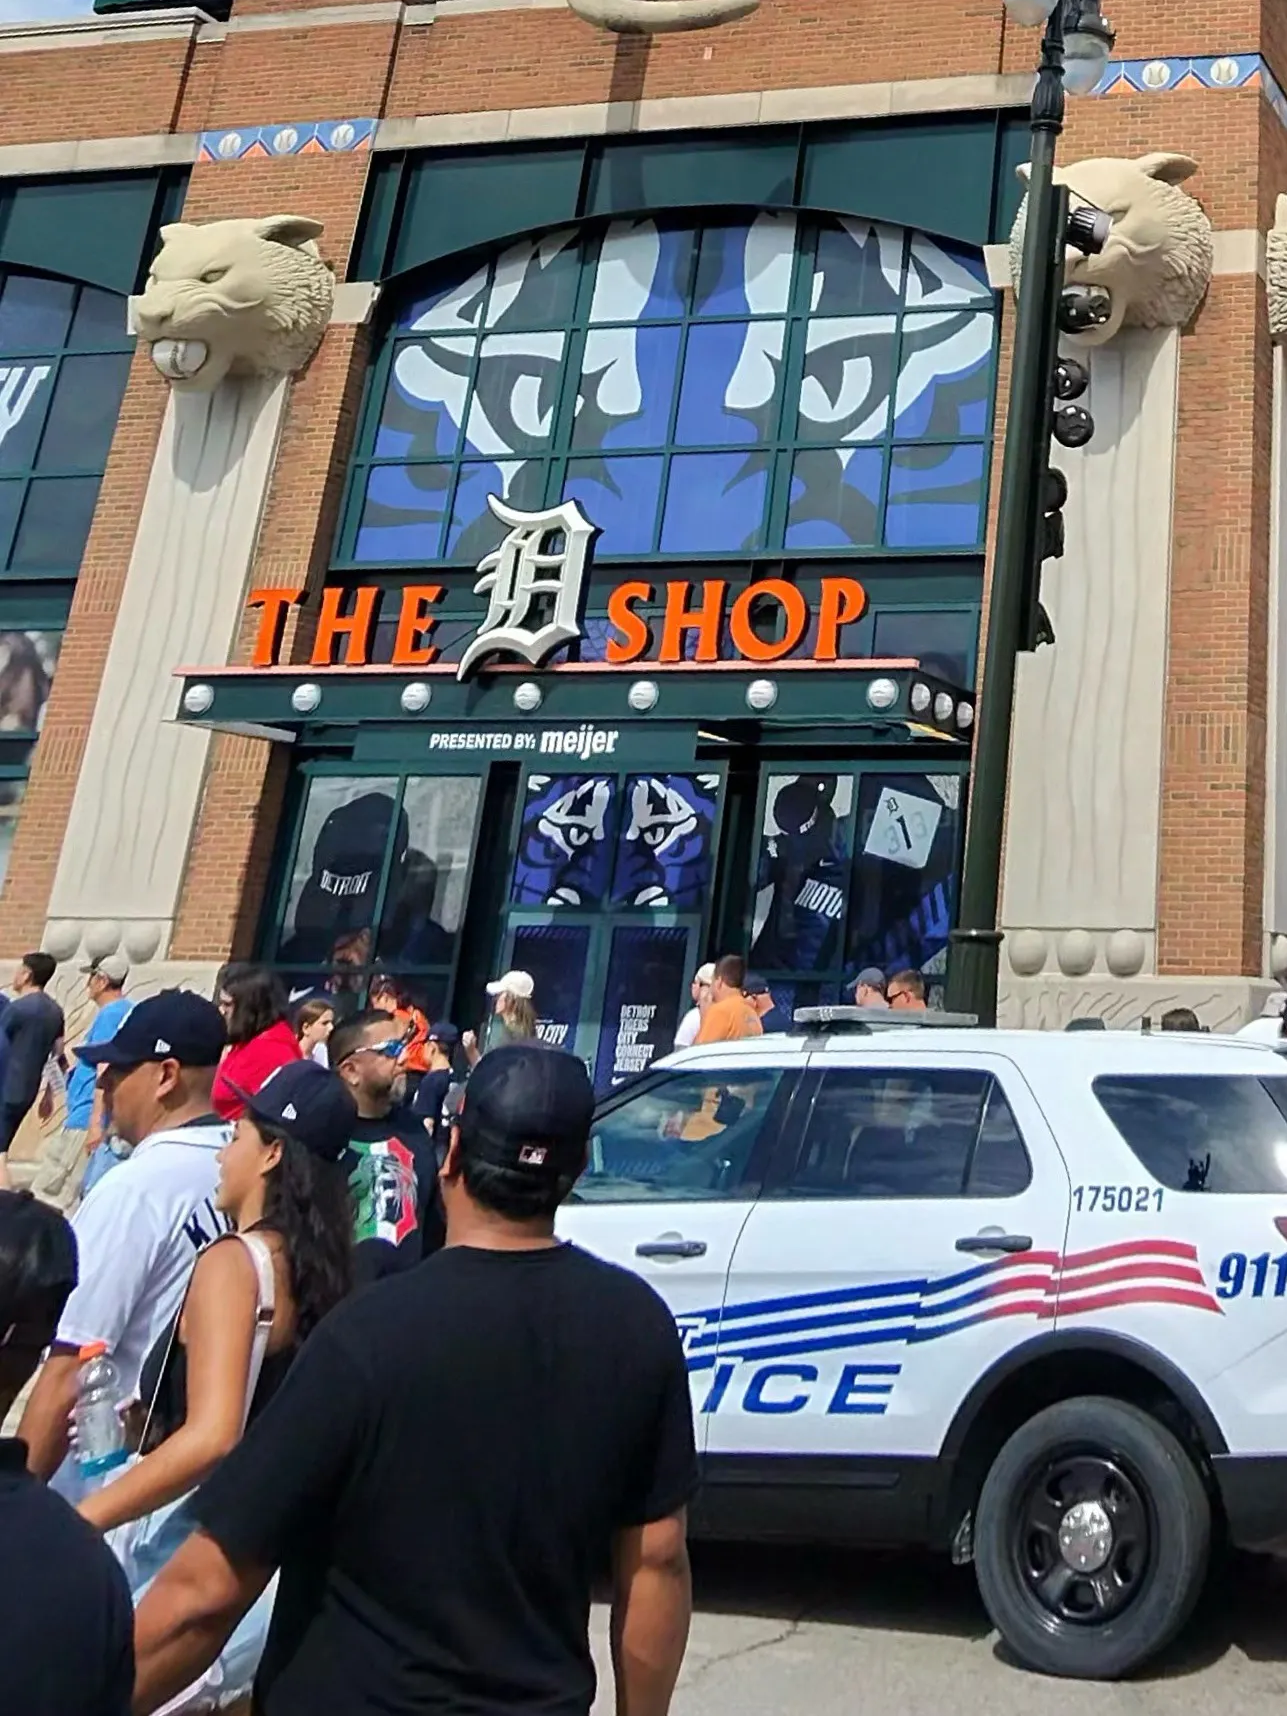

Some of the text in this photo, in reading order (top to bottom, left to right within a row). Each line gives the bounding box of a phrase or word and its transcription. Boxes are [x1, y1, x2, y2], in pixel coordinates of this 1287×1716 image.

[247, 492, 867, 682] THE D SHOP
[429, 733, 536, 750] PRESENTED BY:
[539, 724, 619, 761] meijer
[320, 869, 373, 896] DETROIT
[794, 878, 843, 920] MOTO
[620, 1004, 657, 1020] DETROIT
[543, 1024, 569, 1044] CITY
[619, 1019, 649, 1032] TIGERS
[617, 1031, 638, 1045] CITY
[615, 1044, 655, 1058] CONNECT
[613, 1058, 647, 1072] JERSEY
[1073, 1186, 1164, 1212] 175021
